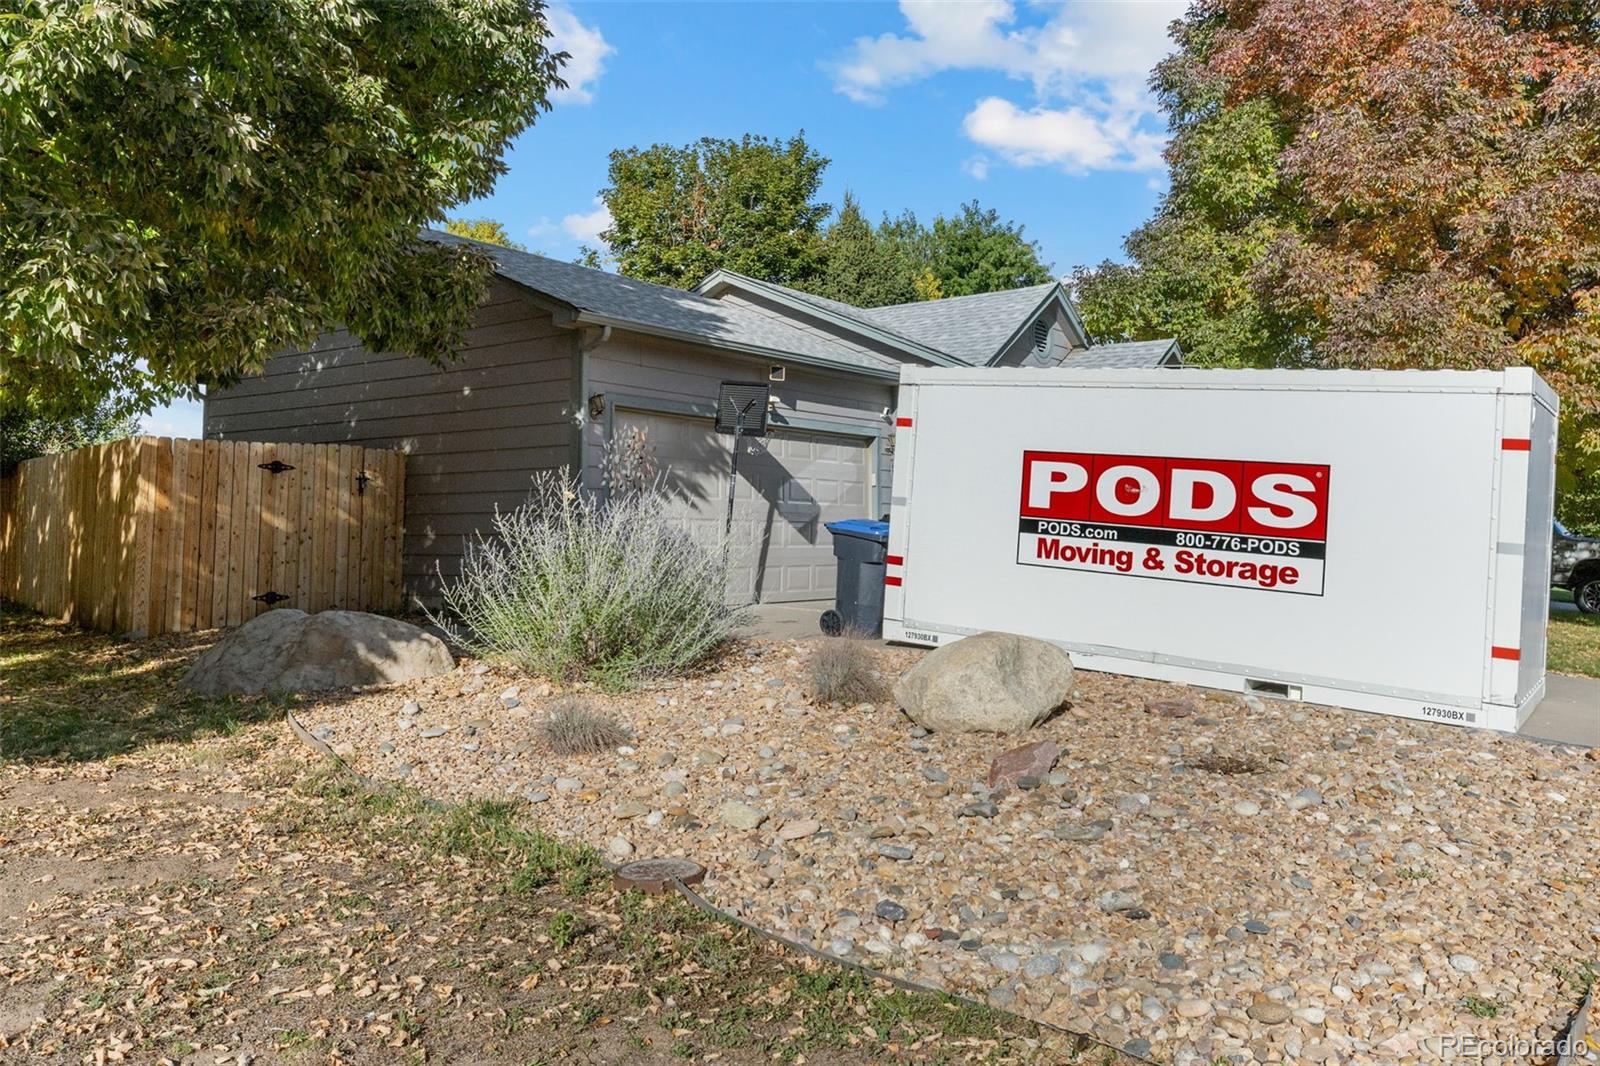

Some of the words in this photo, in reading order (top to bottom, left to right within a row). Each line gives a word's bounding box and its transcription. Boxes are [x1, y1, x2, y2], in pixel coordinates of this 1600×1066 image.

[1028, 460, 1318, 529] PODS
[1037, 521, 1118, 540] PODS.com
[1175, 532, 1301, 556] 800-776-PODS
[1036, 536, 1134, 573] Moving
[1142, 546, 1166, 572] &
[1174, 549, 1300, 589] Storage
[1422, 706, 1465, 721] 127930BX
